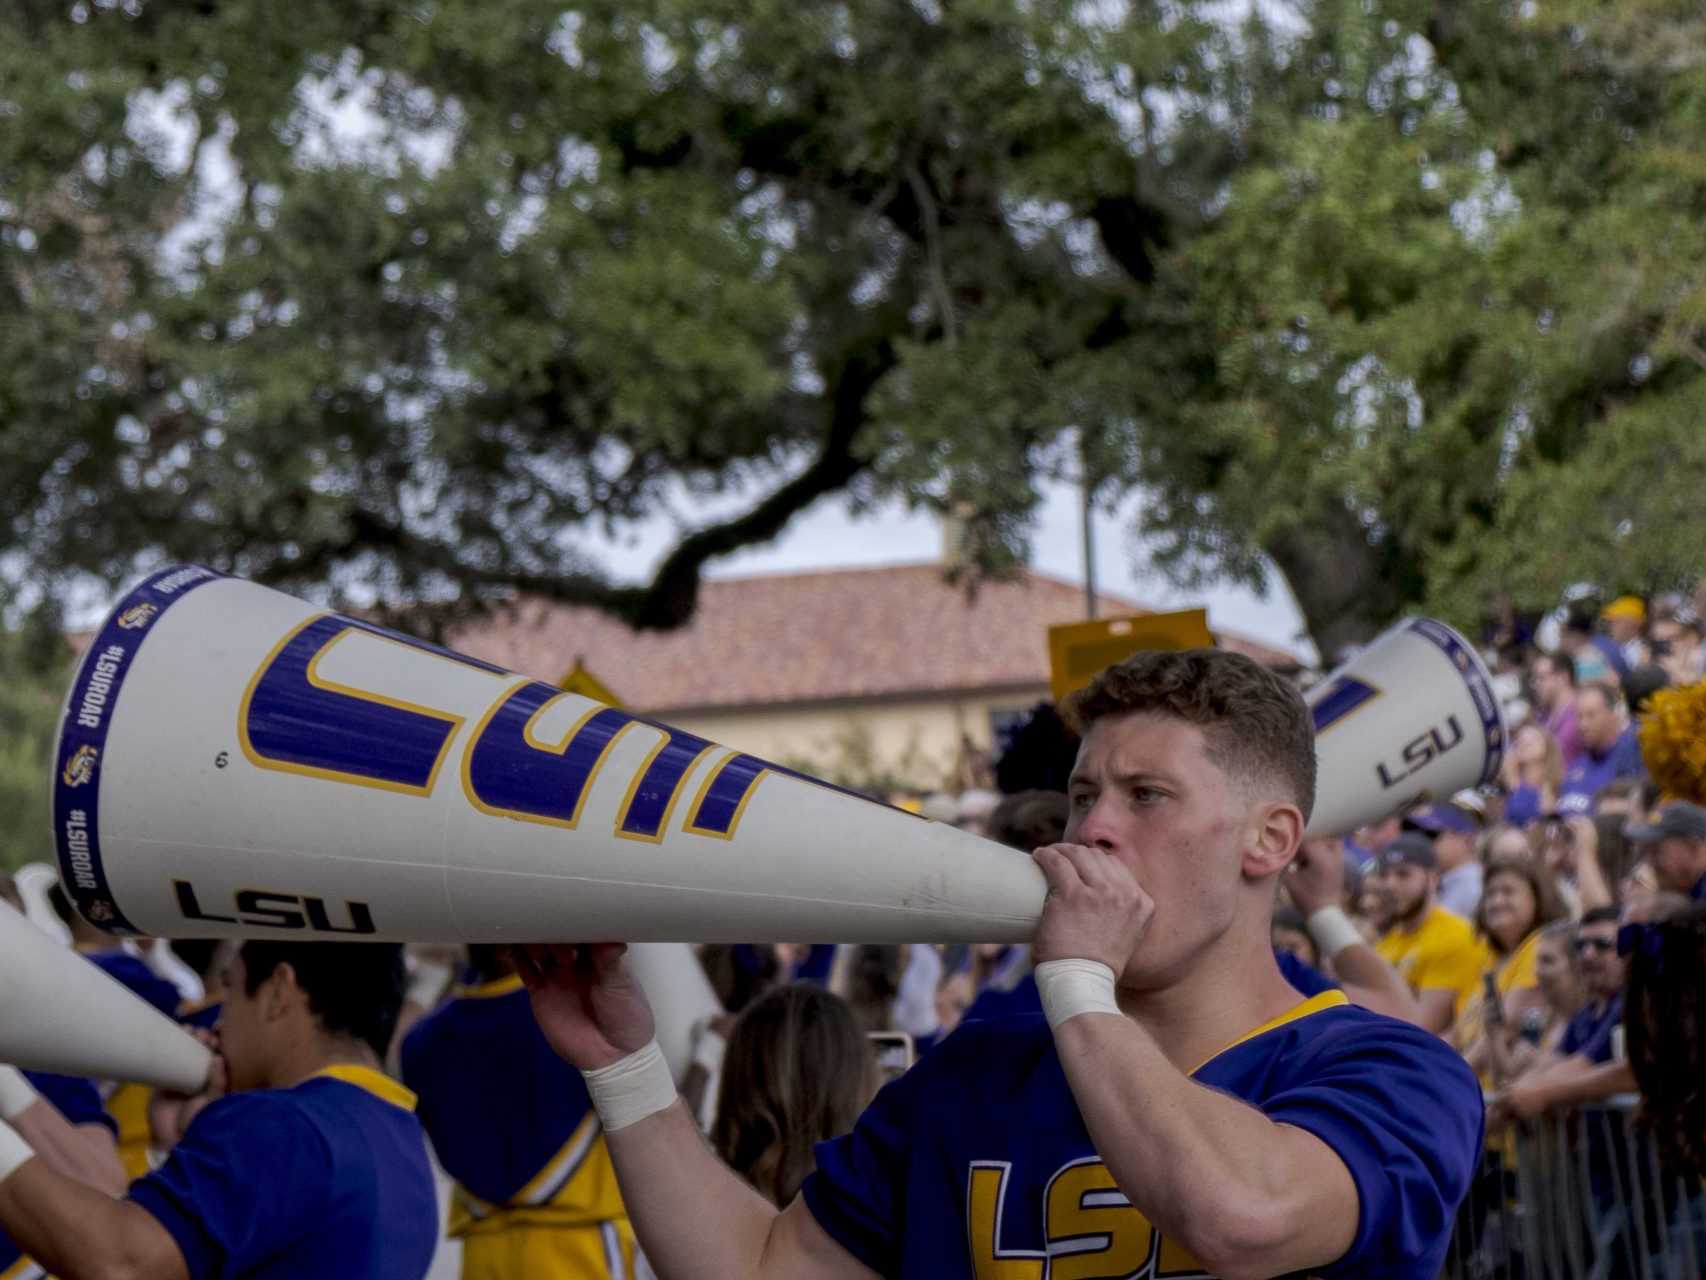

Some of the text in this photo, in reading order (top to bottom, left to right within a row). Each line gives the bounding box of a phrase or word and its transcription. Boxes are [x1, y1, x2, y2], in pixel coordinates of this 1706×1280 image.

[77, 645, 125, 729] #LSUROAR
[214, 751, 229, 769] 6
[1376, 713, 1465, 791] LSU
[66, 809, 98, 889] #LSUROAR
[172, 879, 376, 934] LSU
